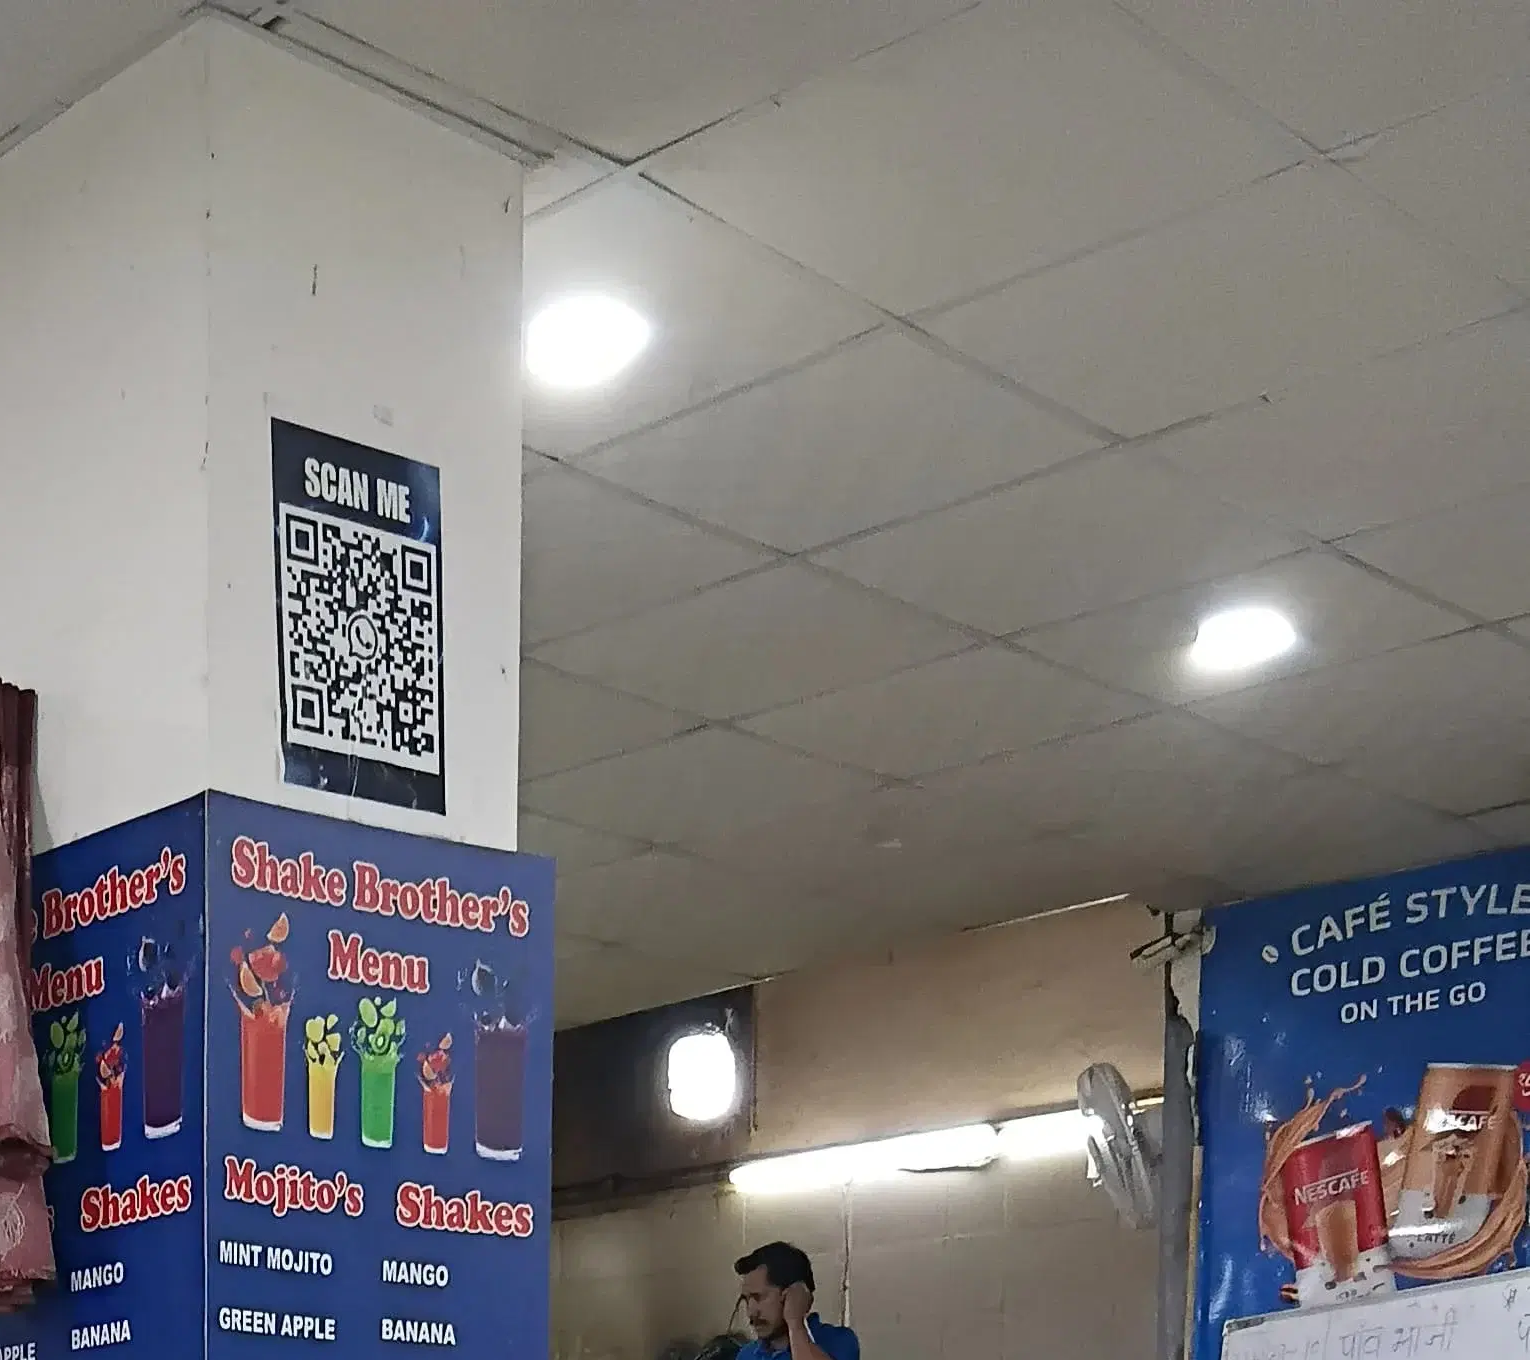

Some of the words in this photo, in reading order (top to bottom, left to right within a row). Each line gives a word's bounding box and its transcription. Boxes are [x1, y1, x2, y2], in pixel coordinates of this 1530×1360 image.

[304, 457, 368, 512] SCAN
[377, 478, 411, 523] ME
[42, 846, 186, 939] Brother's
[231, 836, 346, 907] Shake
[353, 860, 530, 937] Brother's
[1291, 892, 1390, 956] CAFÉ
[1405, 883, 1530, 923] STYLE
[28, 956, 105, 1014] Menu
[328, 929, 429, 994] Menu
[1291, 955, 1385, 996] COLD
[1341, 1002, 1377, 1024] ON
[1387, 988, 1439, 1015] THE
[1449, 981, 1486, 1006] GO
[80, 1175, 192, 1233] Shakes
[223, 1156, 364, 1218] Mojito's
[396, 1181, 535, 1238] Shakes
[71, 1262, 123, 1292] MANGO
[219, 1241, 262, 1266] MINT
[267, 1247, 332, 1275] MOJITO
[383, 1260, 449, 1286] MANGO
[72, 1320, 131, 1349] BANANA
[219, 1308, 275, 1334] GREEN
[281, 1314, 336, 1340] APPLE
[382, 1319, 456, 1345] BANANA
